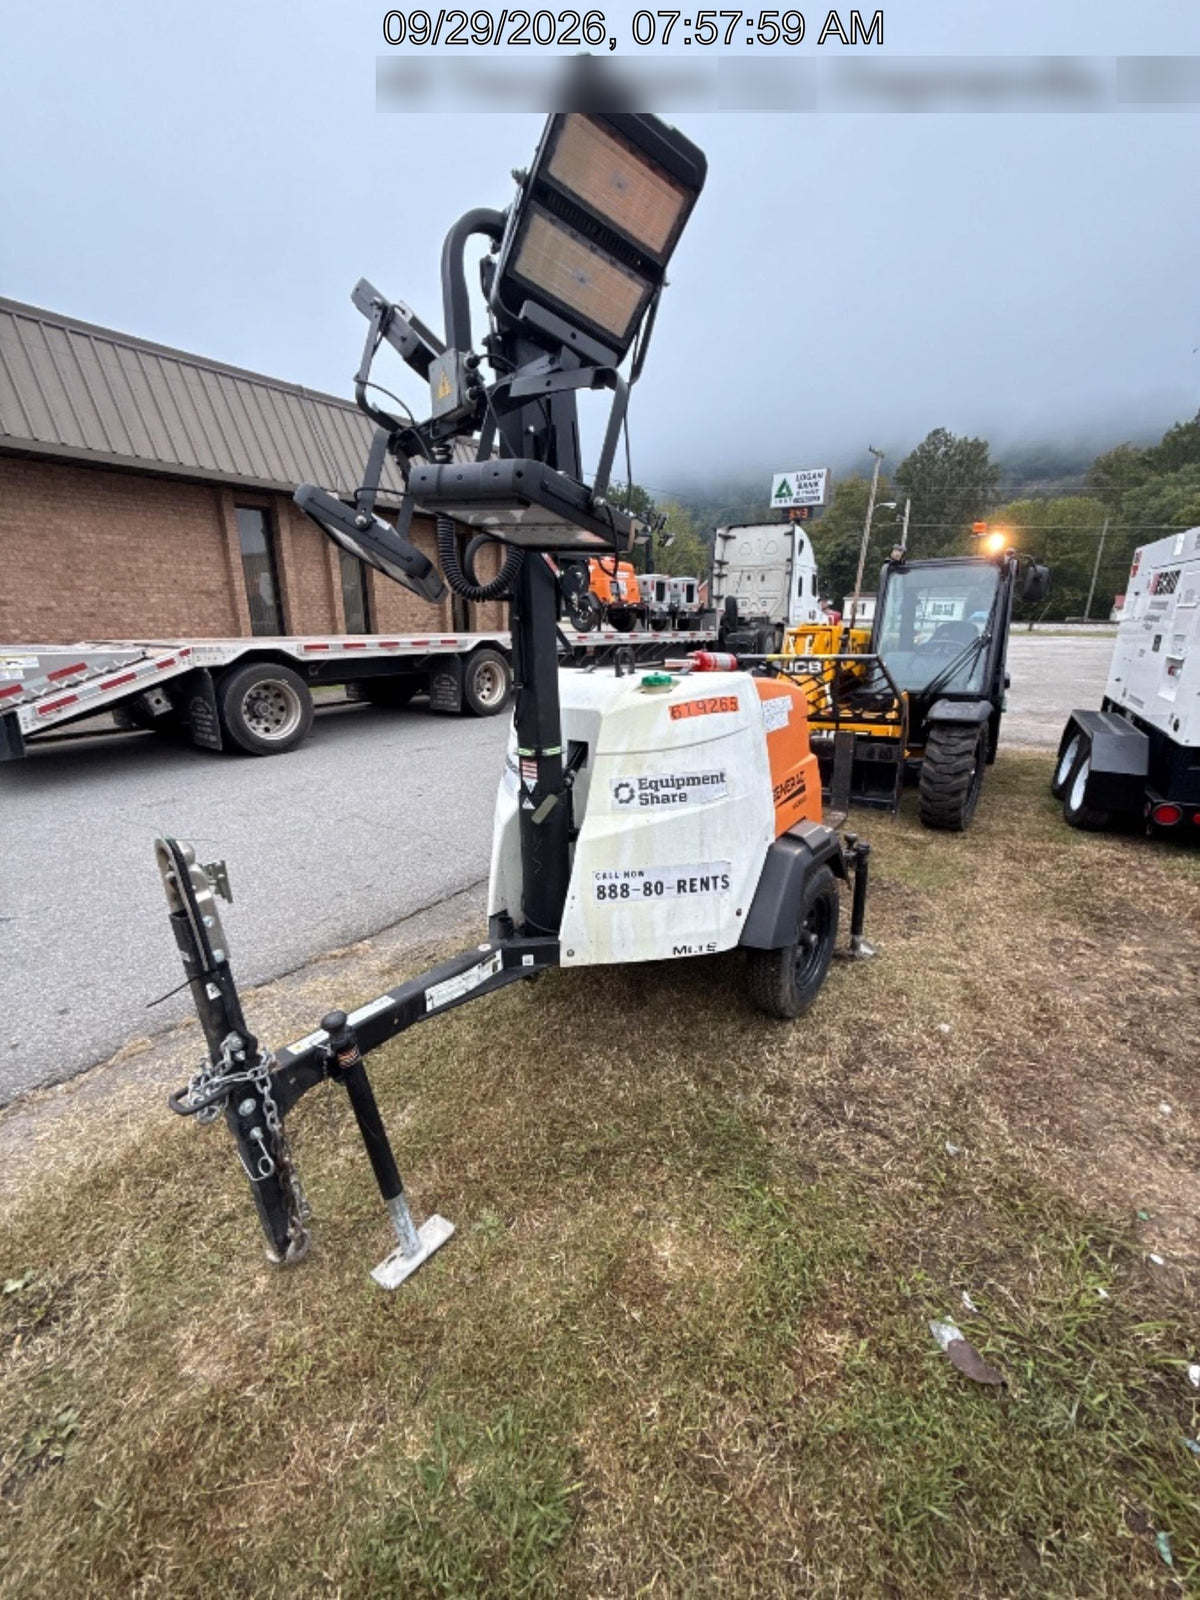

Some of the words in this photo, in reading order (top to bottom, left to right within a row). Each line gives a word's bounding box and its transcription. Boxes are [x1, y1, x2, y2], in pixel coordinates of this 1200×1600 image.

[796, 471, 824, 482] LOGAN
[797, 481, 819, 490] BANK
[783, 661, 822, 673] JCB
[671, 697, 738, 720] 619265
[638, 772, 726, 791] Equipment
[639, 792, 688, 806] Share
[595, 873, 619, 881] CALL
[624, 871, 645, 879] NOW
[596, 874, 730, 900] 888-80-RENTS
